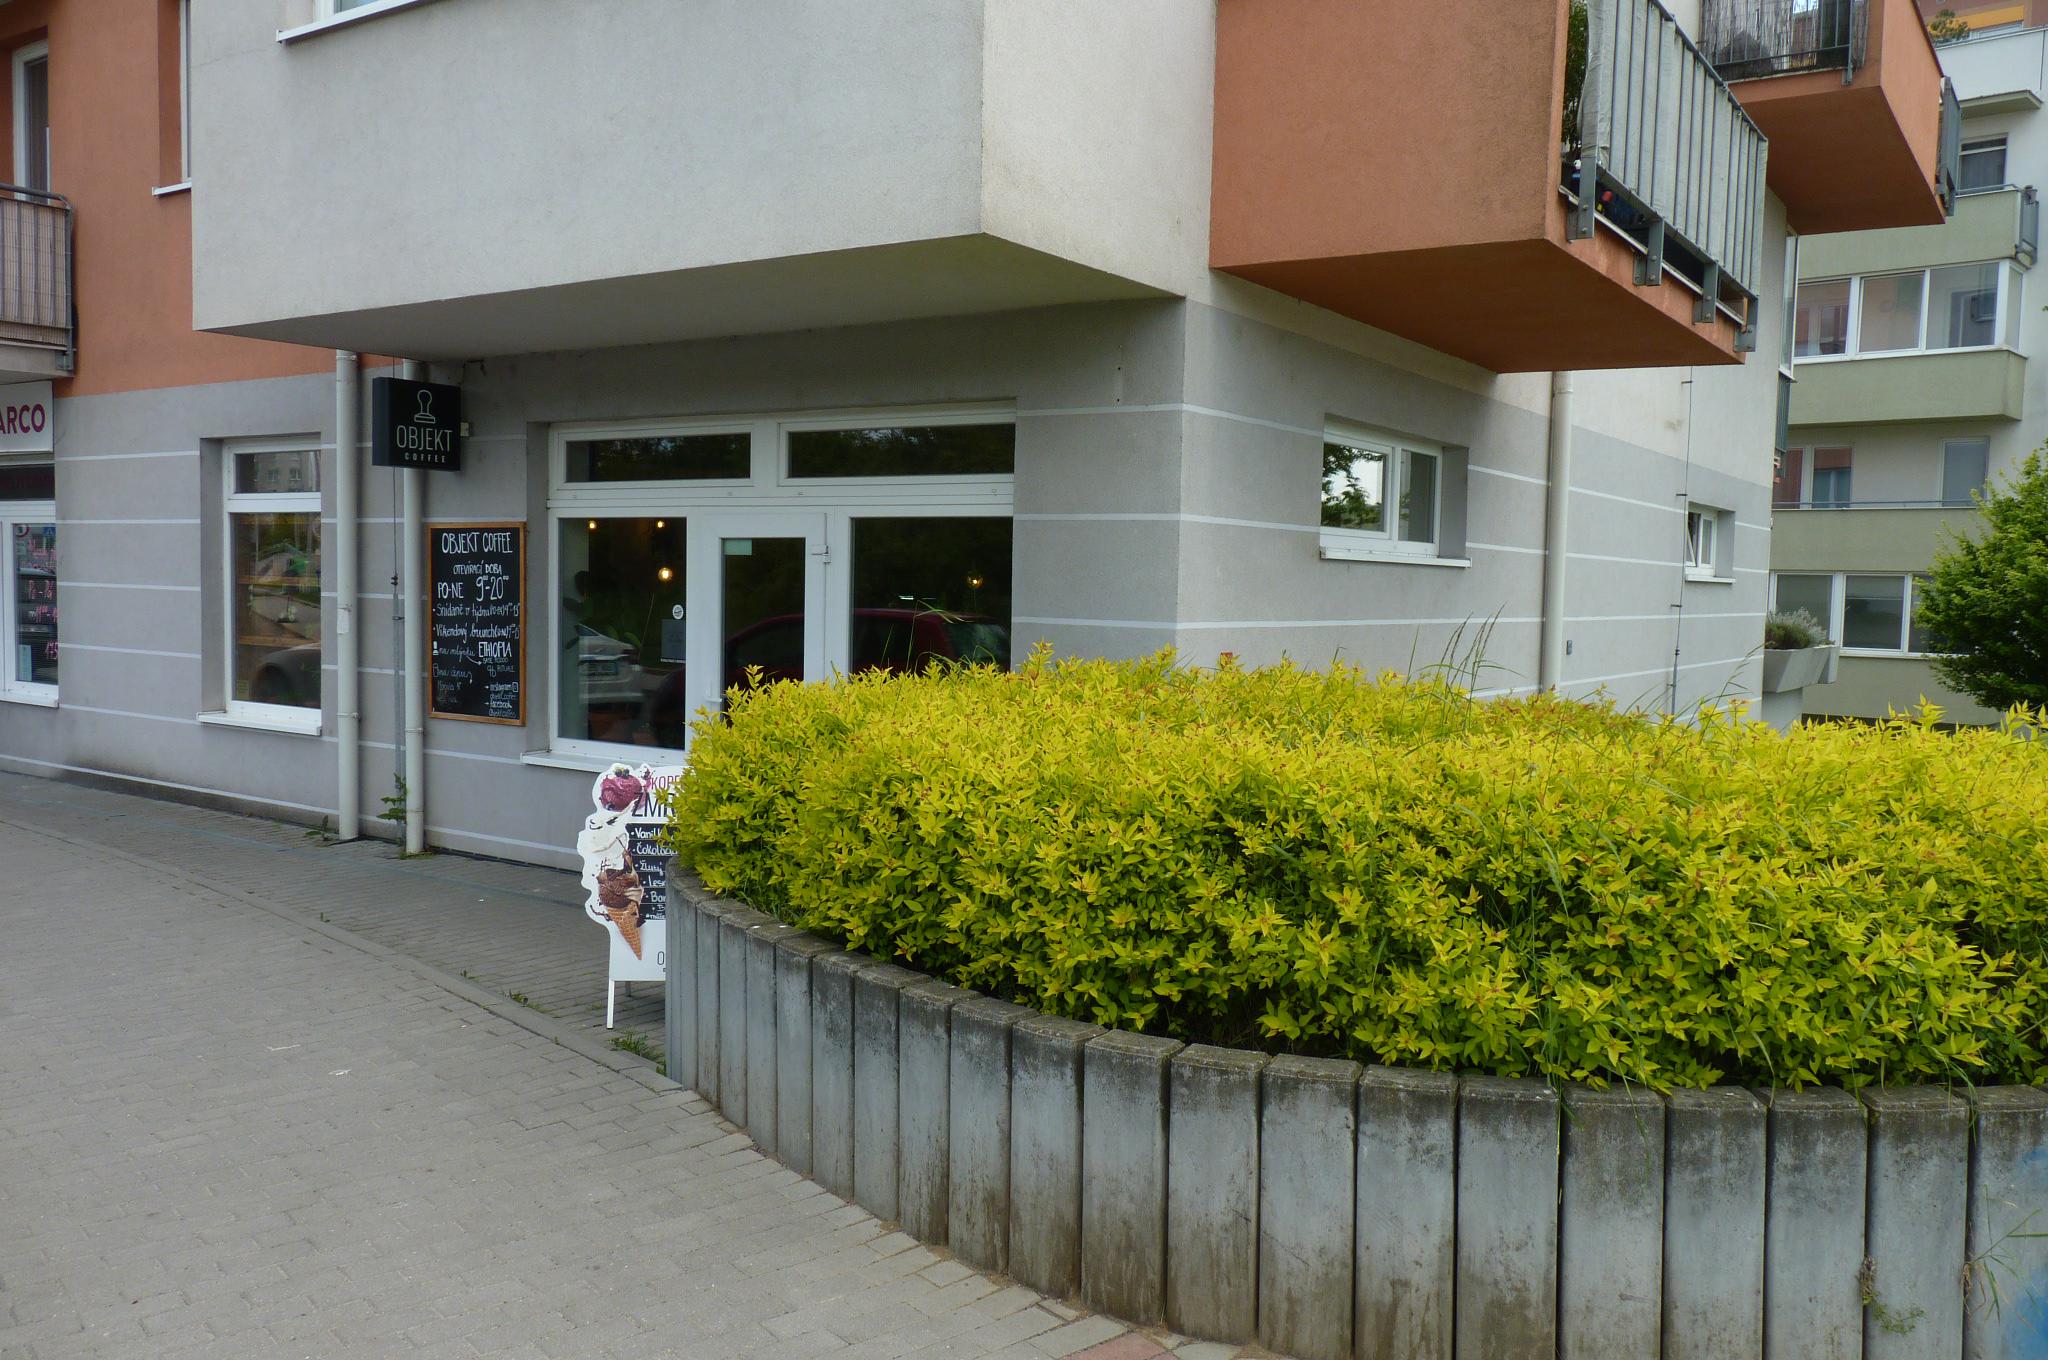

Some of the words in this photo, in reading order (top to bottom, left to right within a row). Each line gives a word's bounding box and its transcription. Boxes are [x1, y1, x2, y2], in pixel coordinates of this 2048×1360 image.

[396, 425, 453, 452] OBJEKT
[404, 452, 446, 463] COFFEE
[441, 532, 480, 554] OBJEKT
[482, 532, 513, 553] COFFEE
[485, 563, 503, 575] DOBA
[437, 581, 465, 599] PO-NE
[478, 641, 513, 658] ETHIOPIA
